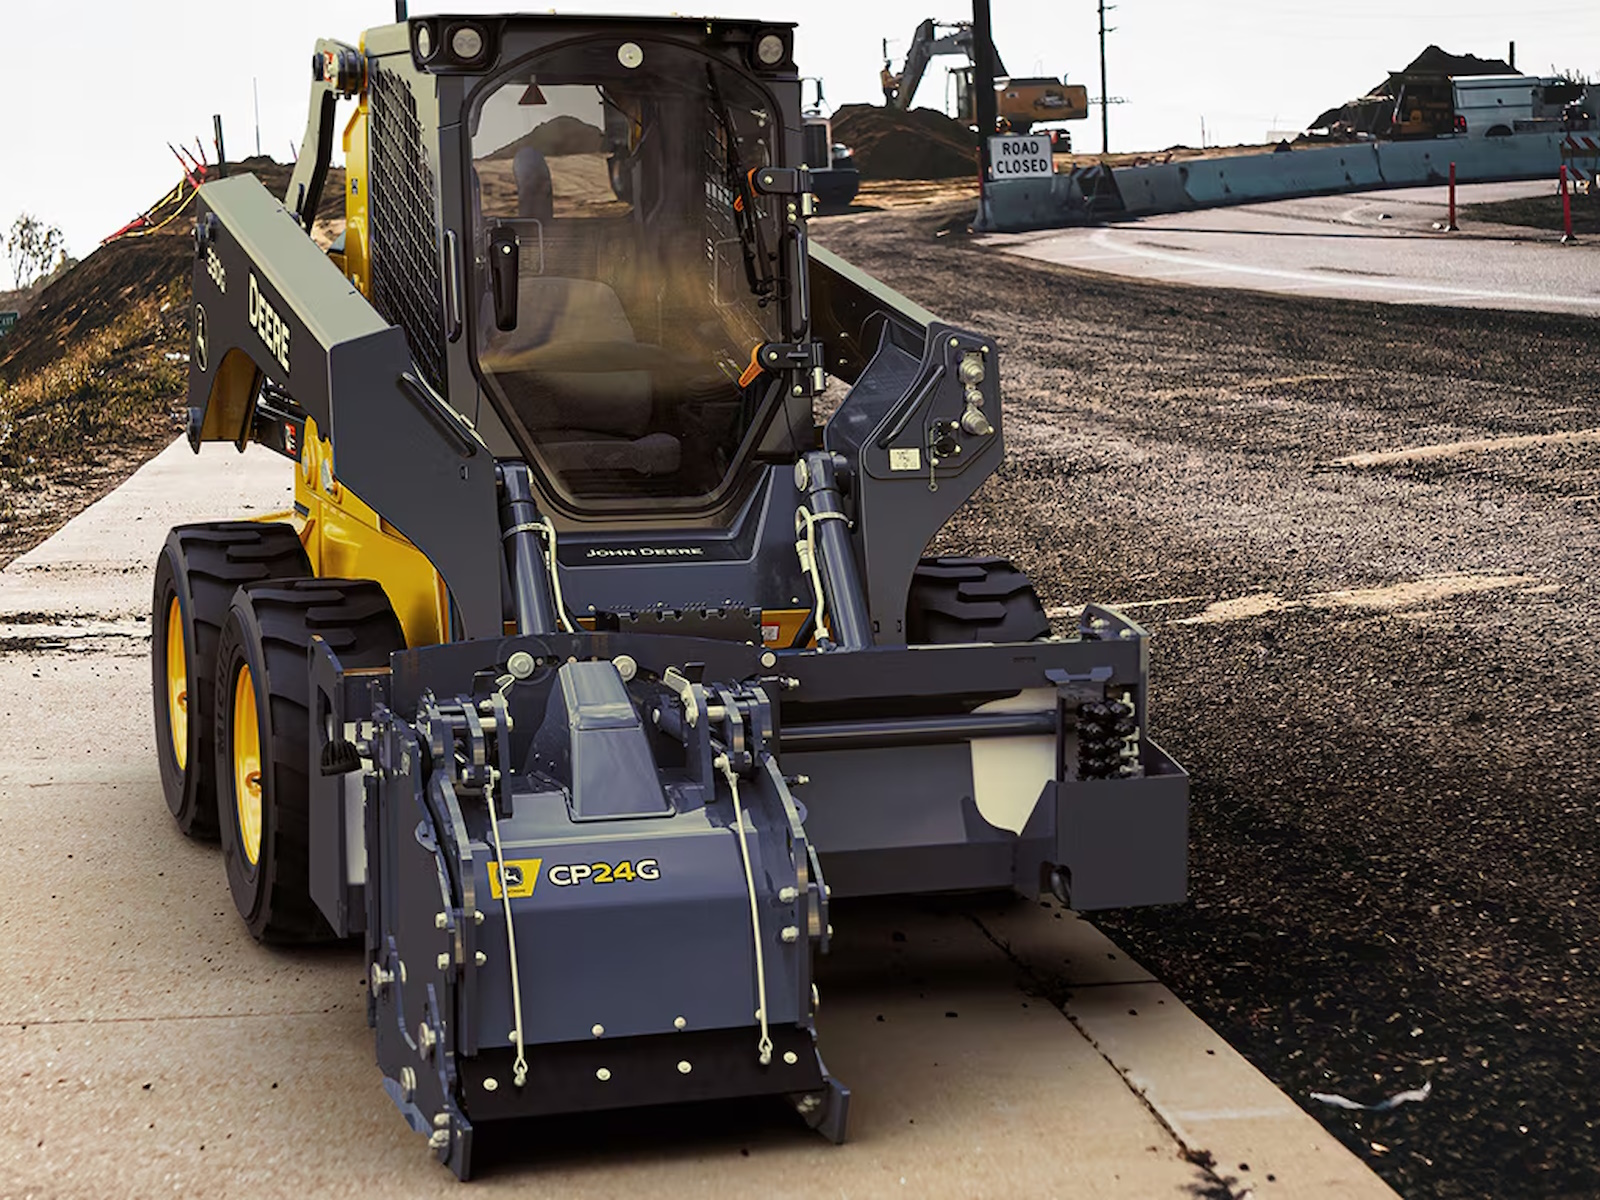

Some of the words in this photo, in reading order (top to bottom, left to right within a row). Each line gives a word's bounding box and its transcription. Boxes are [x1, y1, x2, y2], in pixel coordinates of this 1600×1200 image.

[1003, 141, 1039, 156] ROAD
[997, 159, 1048, 174] CLOSED
[250, 272, 290, 373] DEERE
[586, 548, 637, 558] JOHN
[640, 547, 704, 557] DEERE
[548, 858, 661, 886] CP24G
